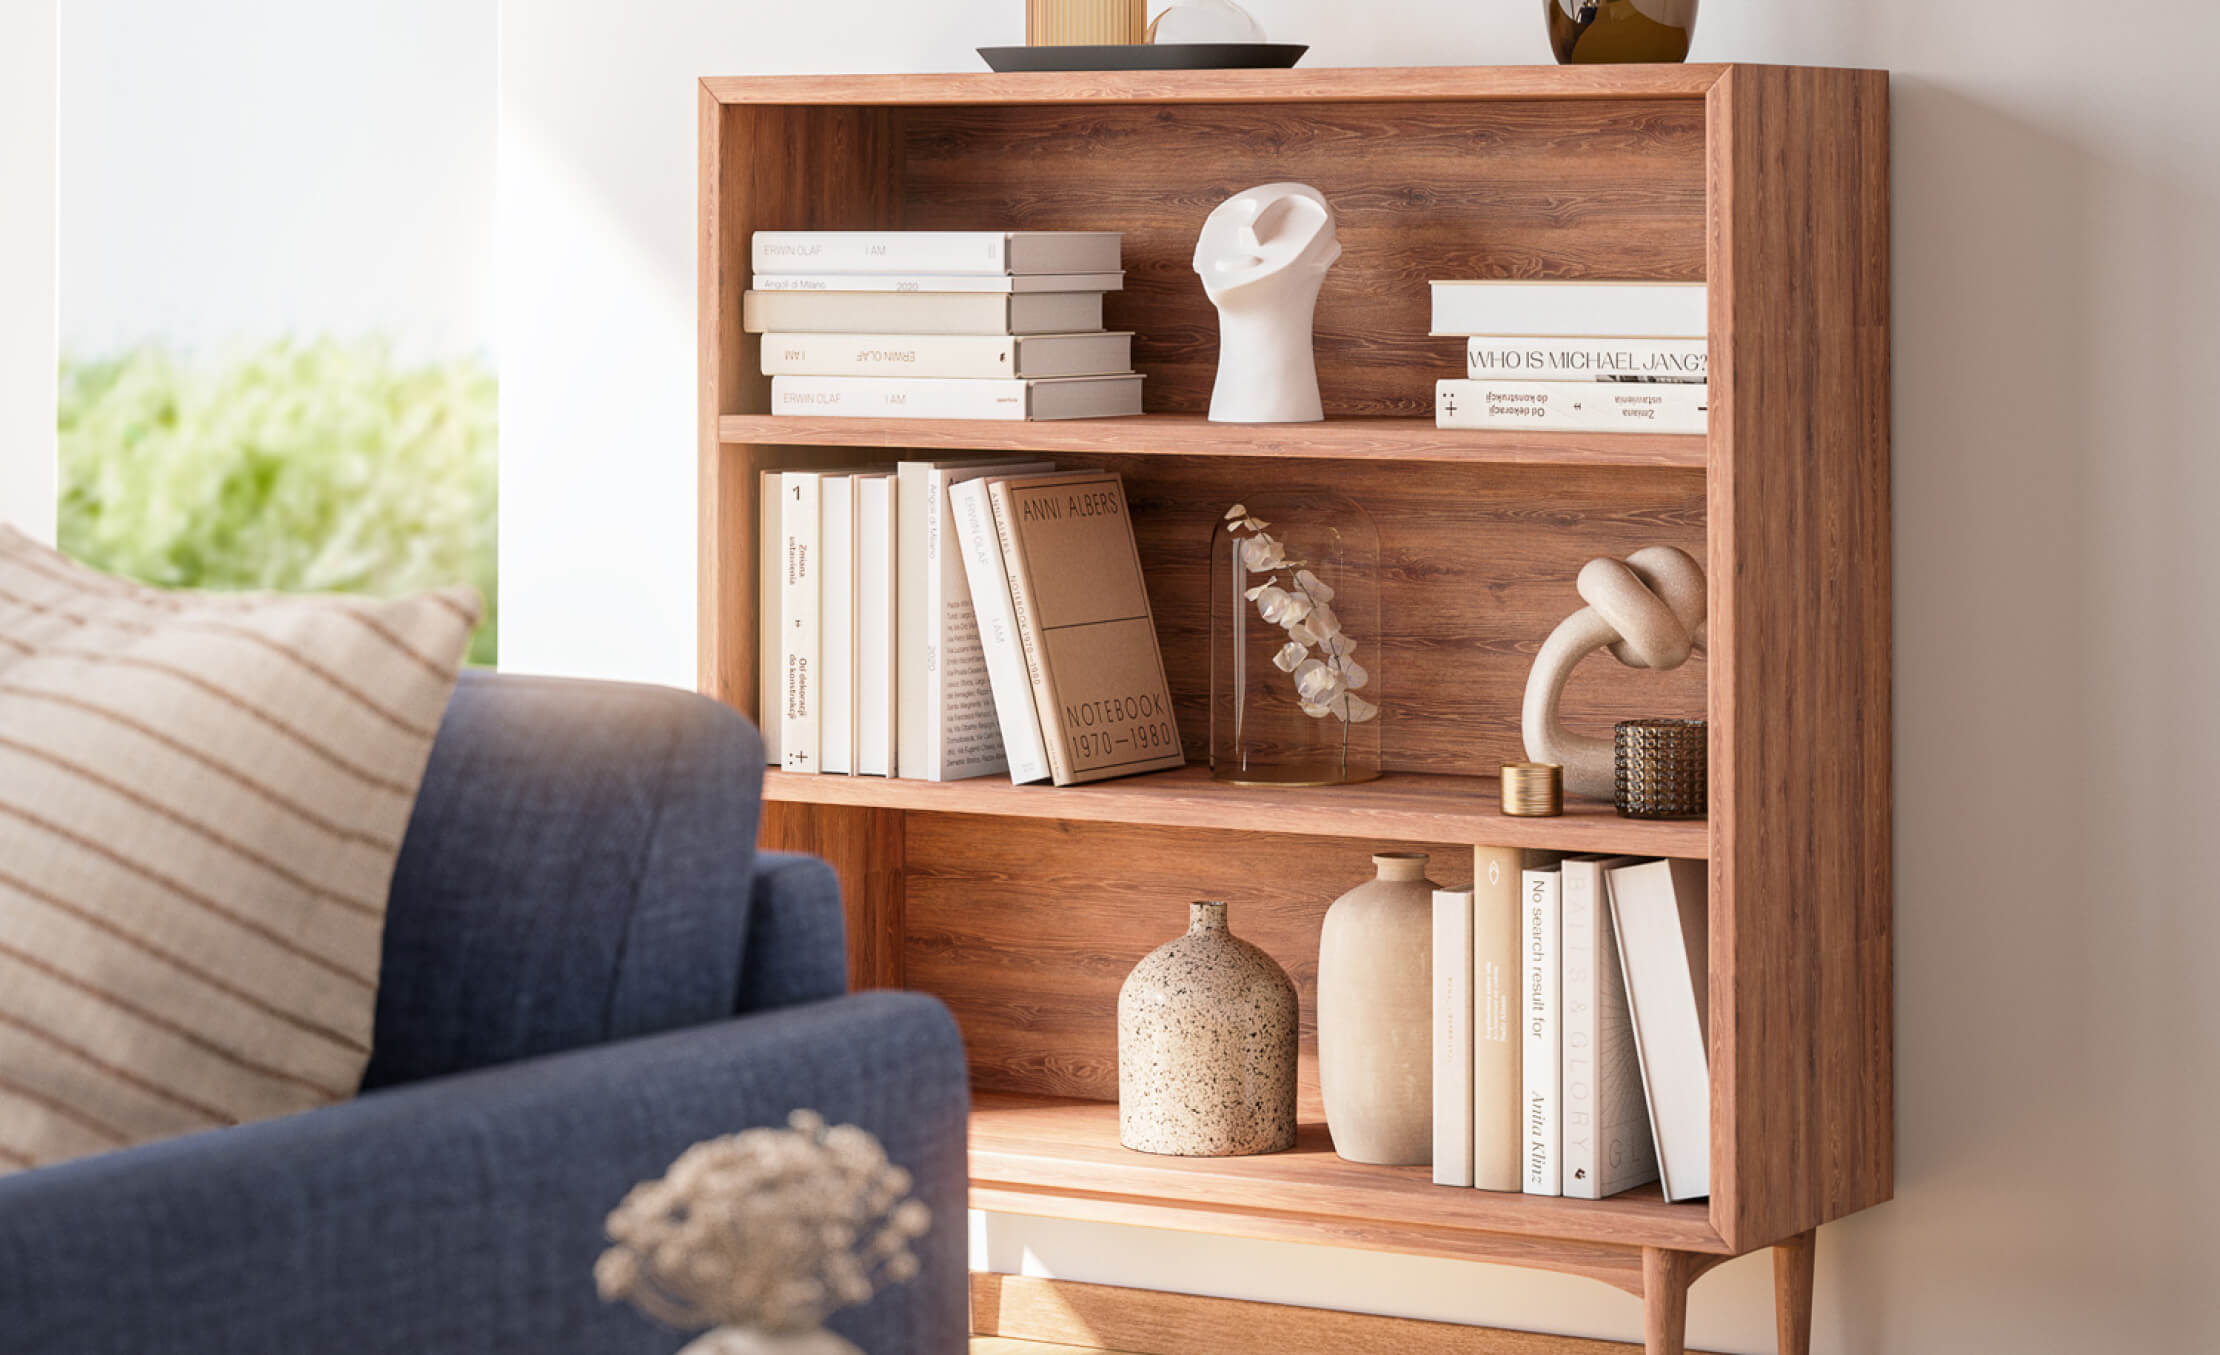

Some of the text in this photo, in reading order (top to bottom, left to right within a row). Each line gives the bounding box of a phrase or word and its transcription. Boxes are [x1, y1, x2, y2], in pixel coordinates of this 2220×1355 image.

[762, 244, 822, 256] ERWIN OLAF
[870, 244, 887, 256] AM
[784, 350, 800, 362] AM
[856, 351, 916, 362] ERWIN OLAF
[1469, 350, 1708, 372] WHO IS MICHAEL JANG?
[784, 392, 840, 405] ERWIN OLAF
[890, 394, 906, 405] AM
[1486, 392, 1548, 404] do konstrukcji
[1489, 405, 1545, 417] Od dekoracji
[1622, 408, 1654, 420] Zmiana
[991, 492, 1000, 518] ANNI
[1022, 492, 1119, 522] ANNI ALBERS
[798, 544, 808, 578] Zmiana
[1010, 576, 1028, 629] NOTEBOOK
[787, 654, 798, 720] do konstrukcji
[797, 658, 808, 717] Od dekoracji
[1066, 693, 1164, 729] NOTEBOOK
[1532, 880, 1544, 1040] No search result for
[1568, 999, 1587, 1016] &
[1567, 1030, 1588, 1153] GLORY
[1530, 1091, 1546, 1184] Anita Klinz
